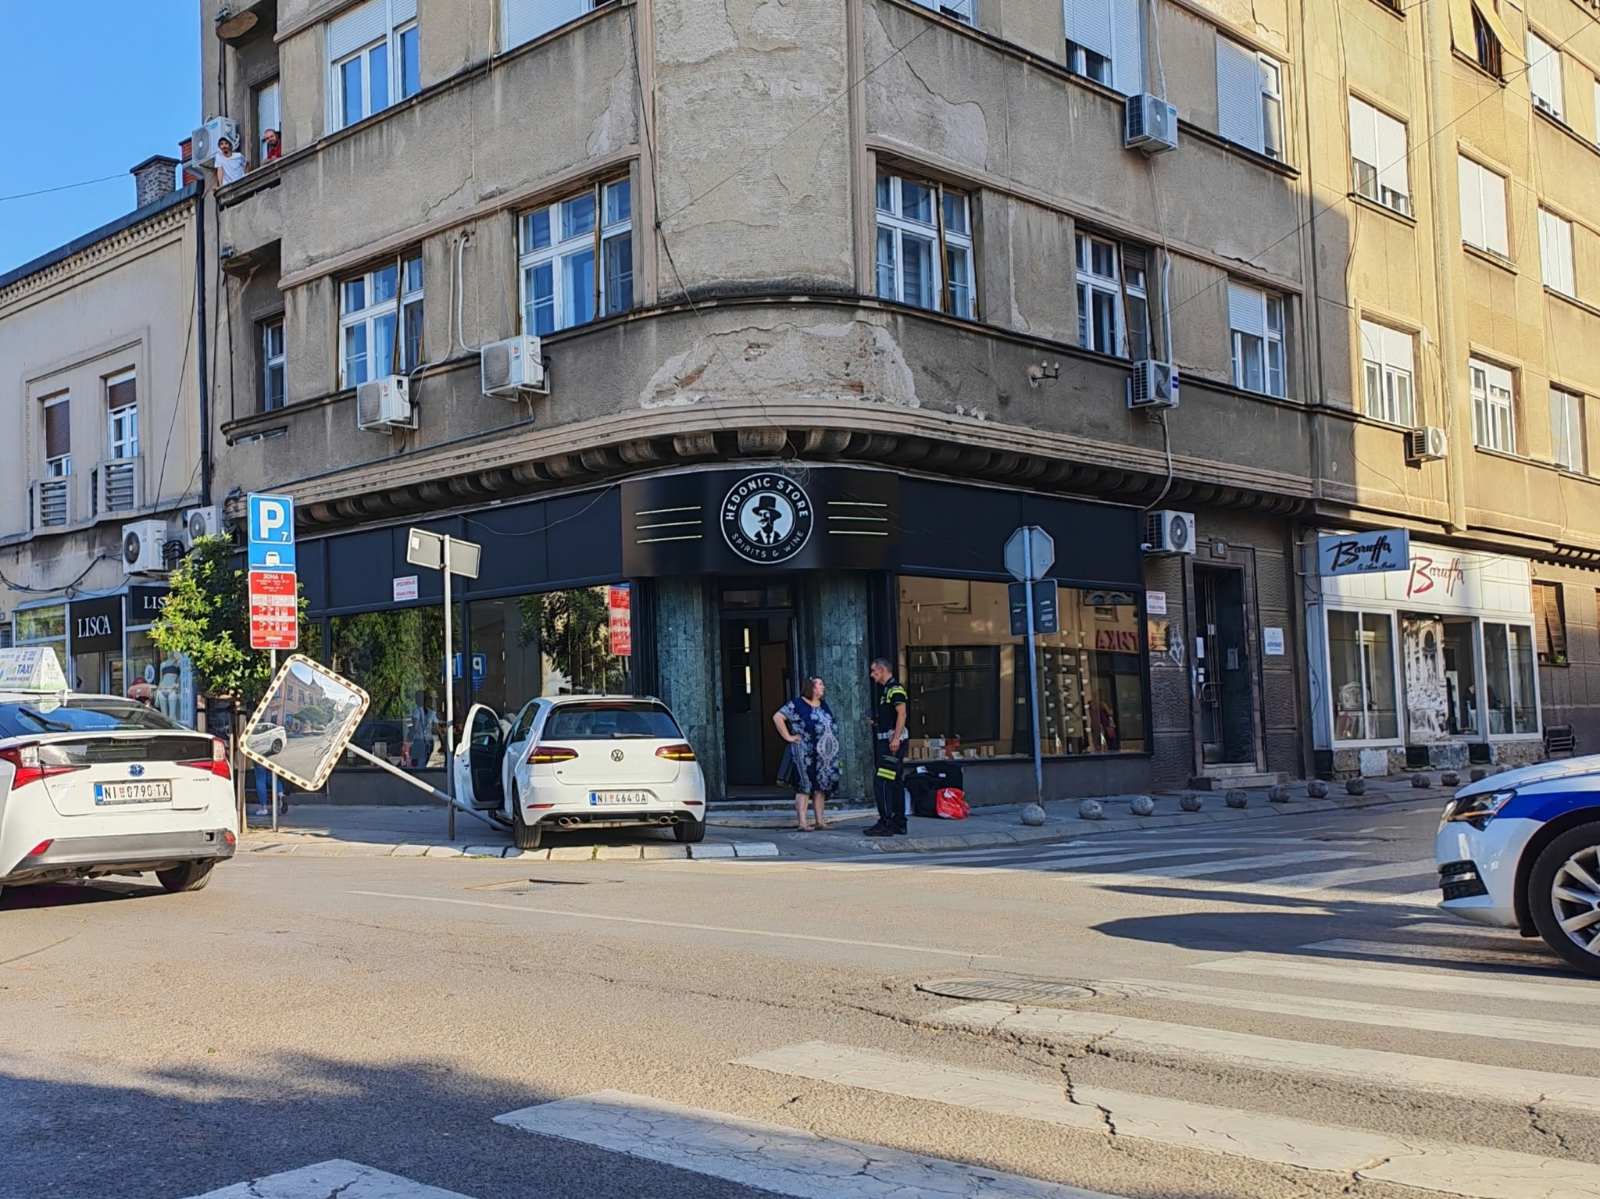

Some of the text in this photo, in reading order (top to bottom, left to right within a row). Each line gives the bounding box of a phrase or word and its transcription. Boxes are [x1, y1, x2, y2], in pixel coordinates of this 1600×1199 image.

[725, 477, 809, 520] HEDONIC STORE
[259, 500, 285, 540] P
[731, 533, 767, 558] SPIRITS
[783, 530, 805, 553] WINE
[1325, 534, 1393, 572] Baruffa
[1407, 553, 1465, 599] Baruffa
[77, 614, 112, 638] LISCA
[104, 784, 117, 799] NI
[597, 794, 607, 802] NI
